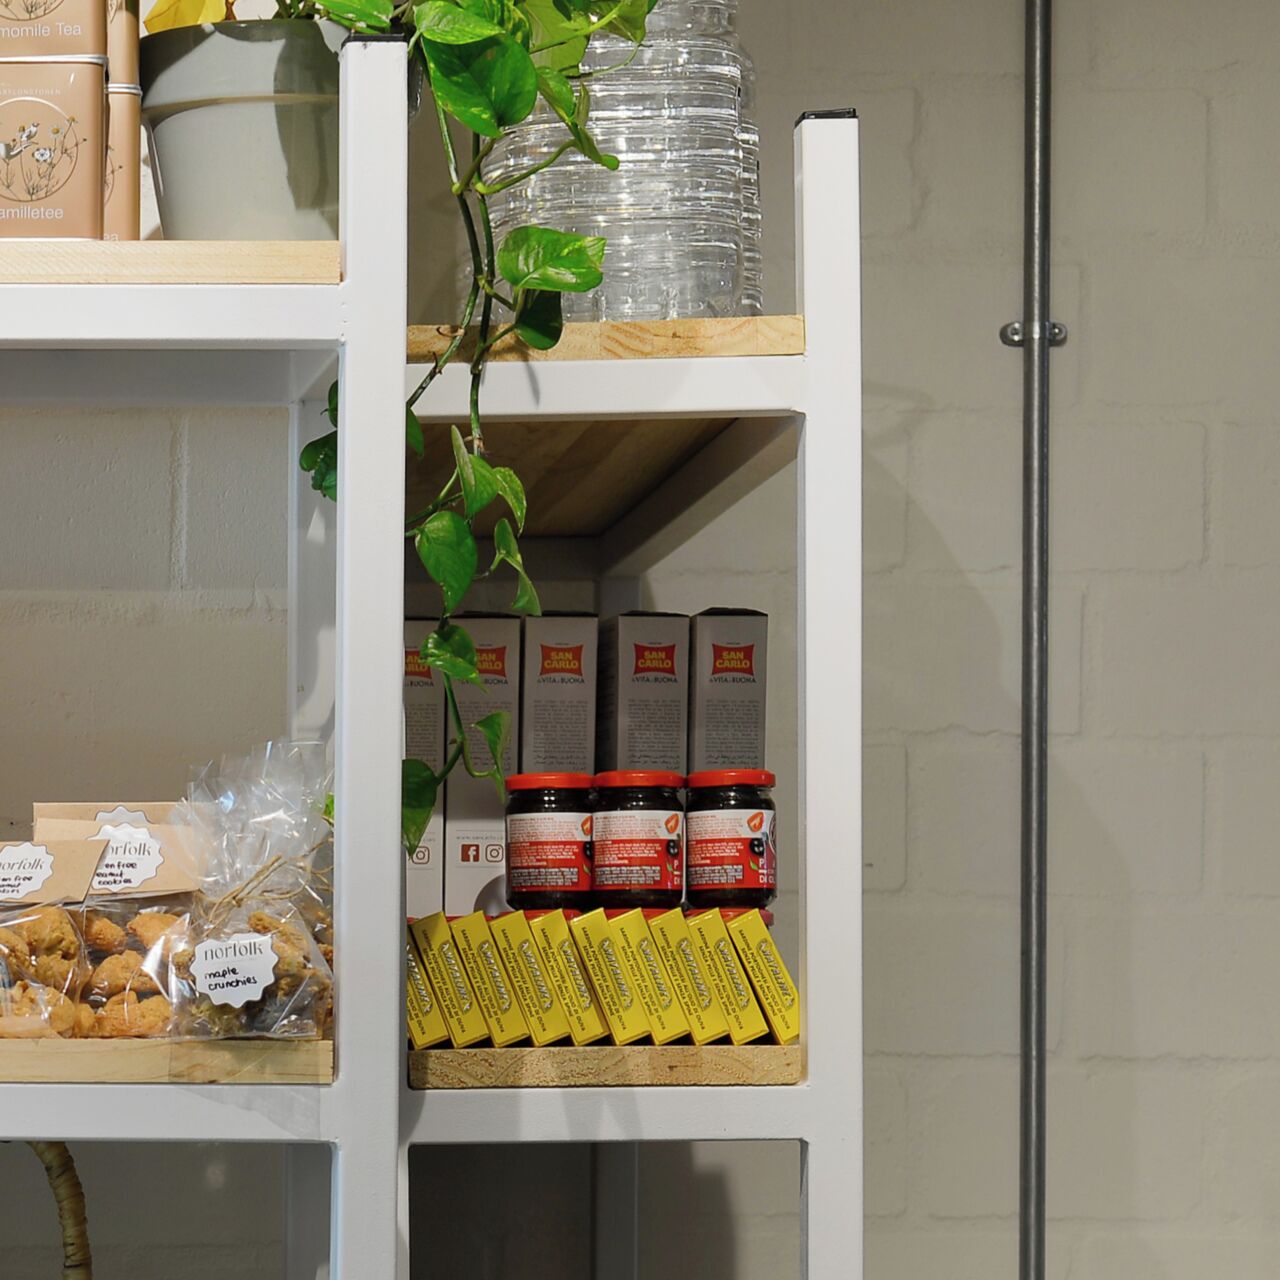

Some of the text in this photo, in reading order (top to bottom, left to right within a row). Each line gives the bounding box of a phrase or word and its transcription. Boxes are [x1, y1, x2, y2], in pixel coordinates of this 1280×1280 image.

[55, 22, 82, 37] Tea
[550, 650, 573, 661] SAN
[643, 650, 666, 661] SAN
[722, 650, 744, 661] SAN
[543, 658, 579, 670] CARLO
[638, 658, 672, 669] CARLO
[715, 658, 750, 669] CARLO
[204, 941, 263, 961] norfolk
[205, 966, 240, 980] maple
[208, 975, 258, 991] crunchies
